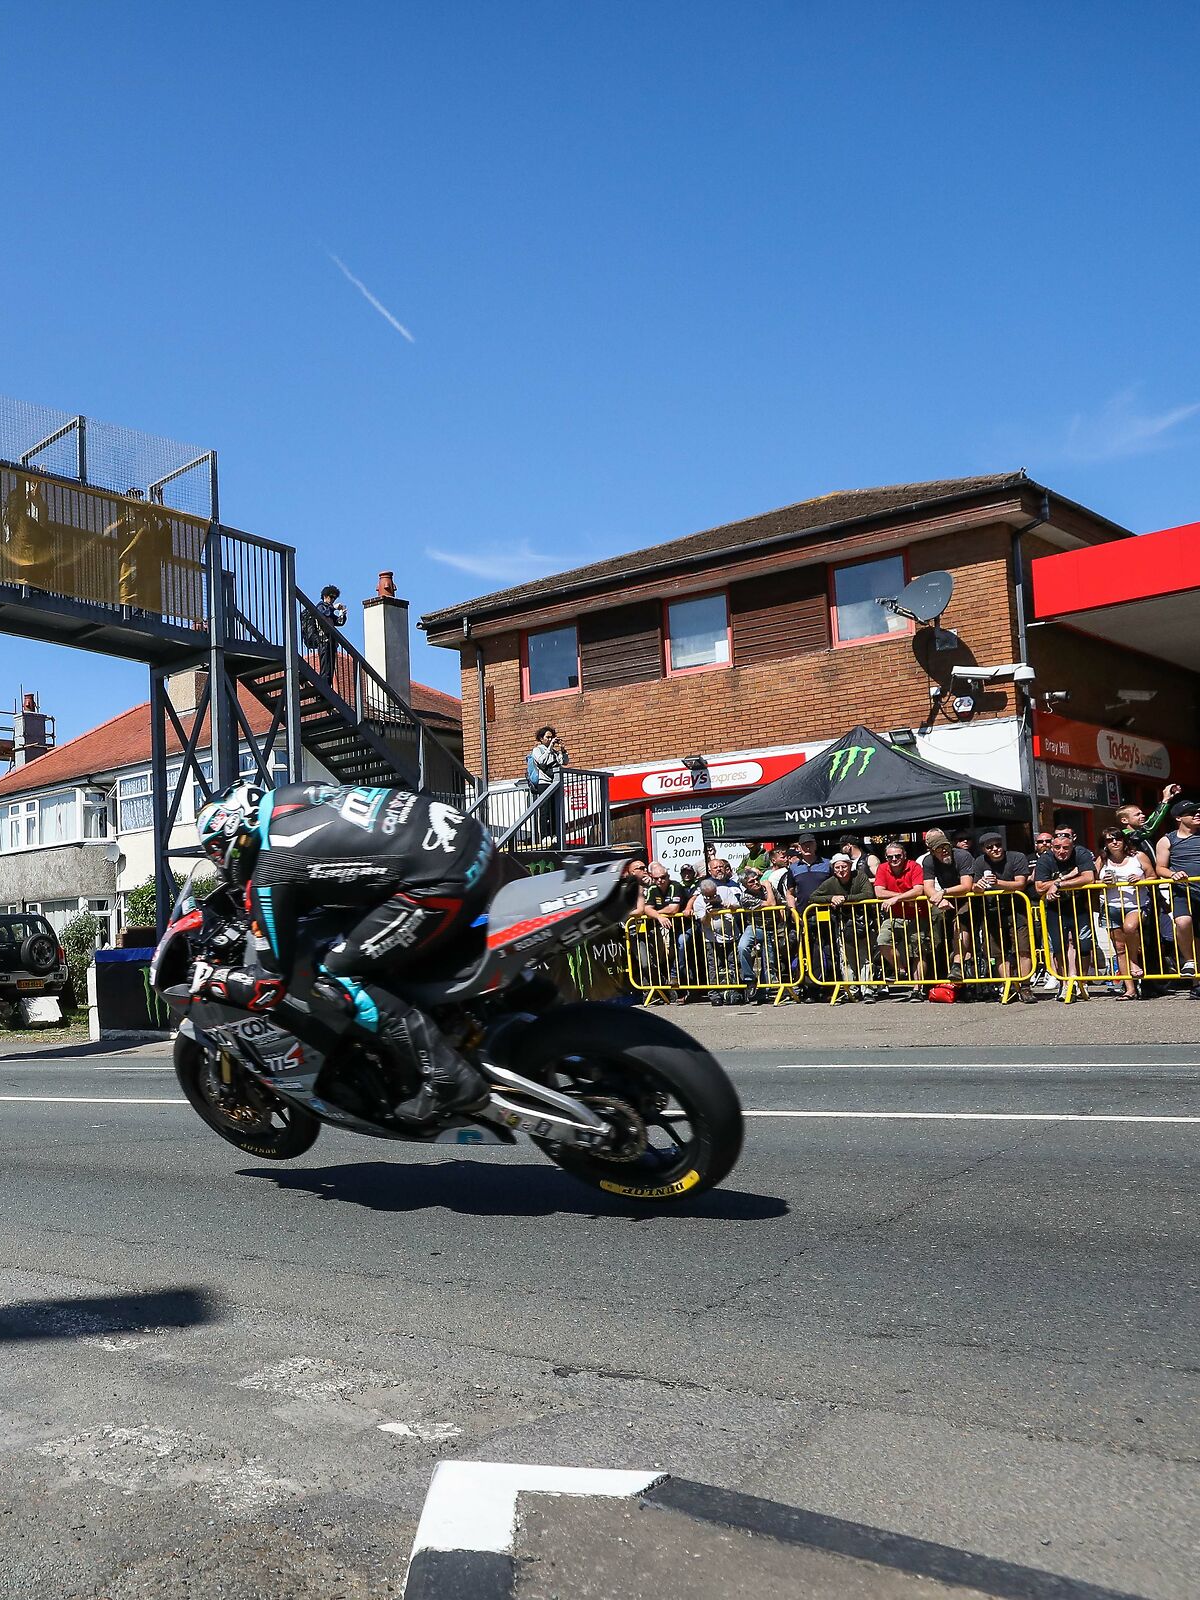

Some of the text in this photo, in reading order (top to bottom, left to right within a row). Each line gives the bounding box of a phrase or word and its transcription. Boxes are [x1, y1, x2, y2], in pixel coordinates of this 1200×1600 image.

[1045, 738, 1070, 756] Bray Hill
[1106, 735, 1140, 769] Today's
[658, 770, 748, 789] Today's express
[1050, 765, 1066, 780] Open
[785, 802, 871, 823] MONSTER
[799, 818, 859, 830] ENERGY
[667, 835, 694, 846] Open
[661, 848, 701, 859] 6.30am
[622, 1181, 685, 1197] DUNLOP
